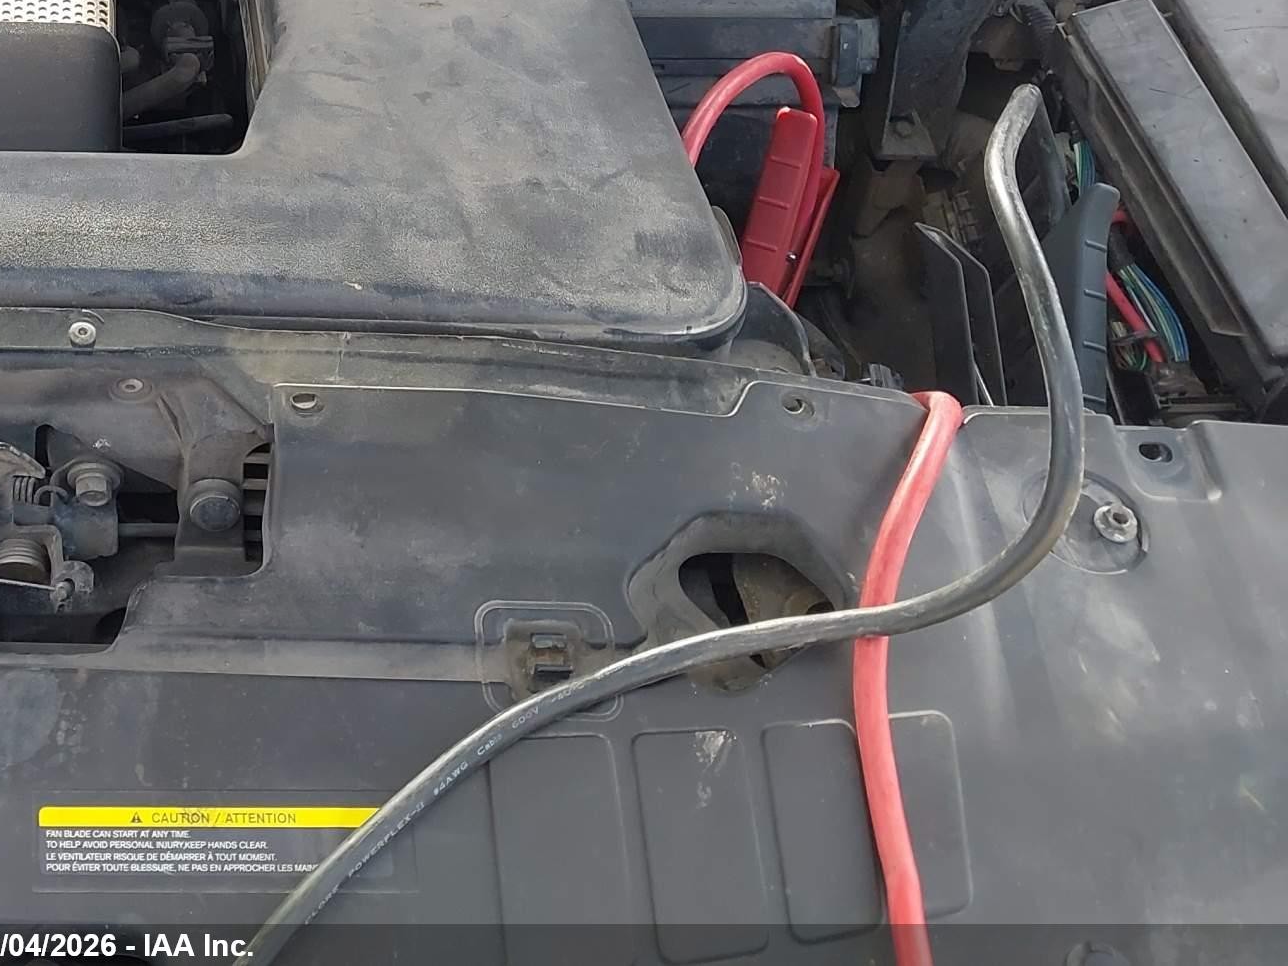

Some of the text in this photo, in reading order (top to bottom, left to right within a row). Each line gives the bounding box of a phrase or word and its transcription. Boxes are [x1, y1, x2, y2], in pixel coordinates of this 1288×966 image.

[151, 812, 296, 824] CAUTION / ATTENTION
[46, 830, 191, 838] FAN BLADE CAN START AT ANY TIME.
[46, 841, 58, 849] TO
[59, 841, 81, 849] HELP
[82, 841, 108, 849] AVOID
[109, 841, 154, 849] PERSONAL
[207, 841, 238, 849] HANDS
[238, 841, 268, 849] CLEAR.
[46, 851, 277, 861] LE VENTILATEUR RISQUE DE DÉMARRER À TOUT MOMENT.
[46, 863, 71, 872] POUR
[72, 861, 101, 872] ÉVITER
[102, 863, 130, 872] TOUTE
[130, 863, 176, 872] BLESSURE,
[178, 863, 190, 872] NE
[191, 863, 209, 872] PAS
[210, 863, 222, 872] EN
[223, 863, 276, 872] APPROCHER
[277, 863, 293, 872] LES
